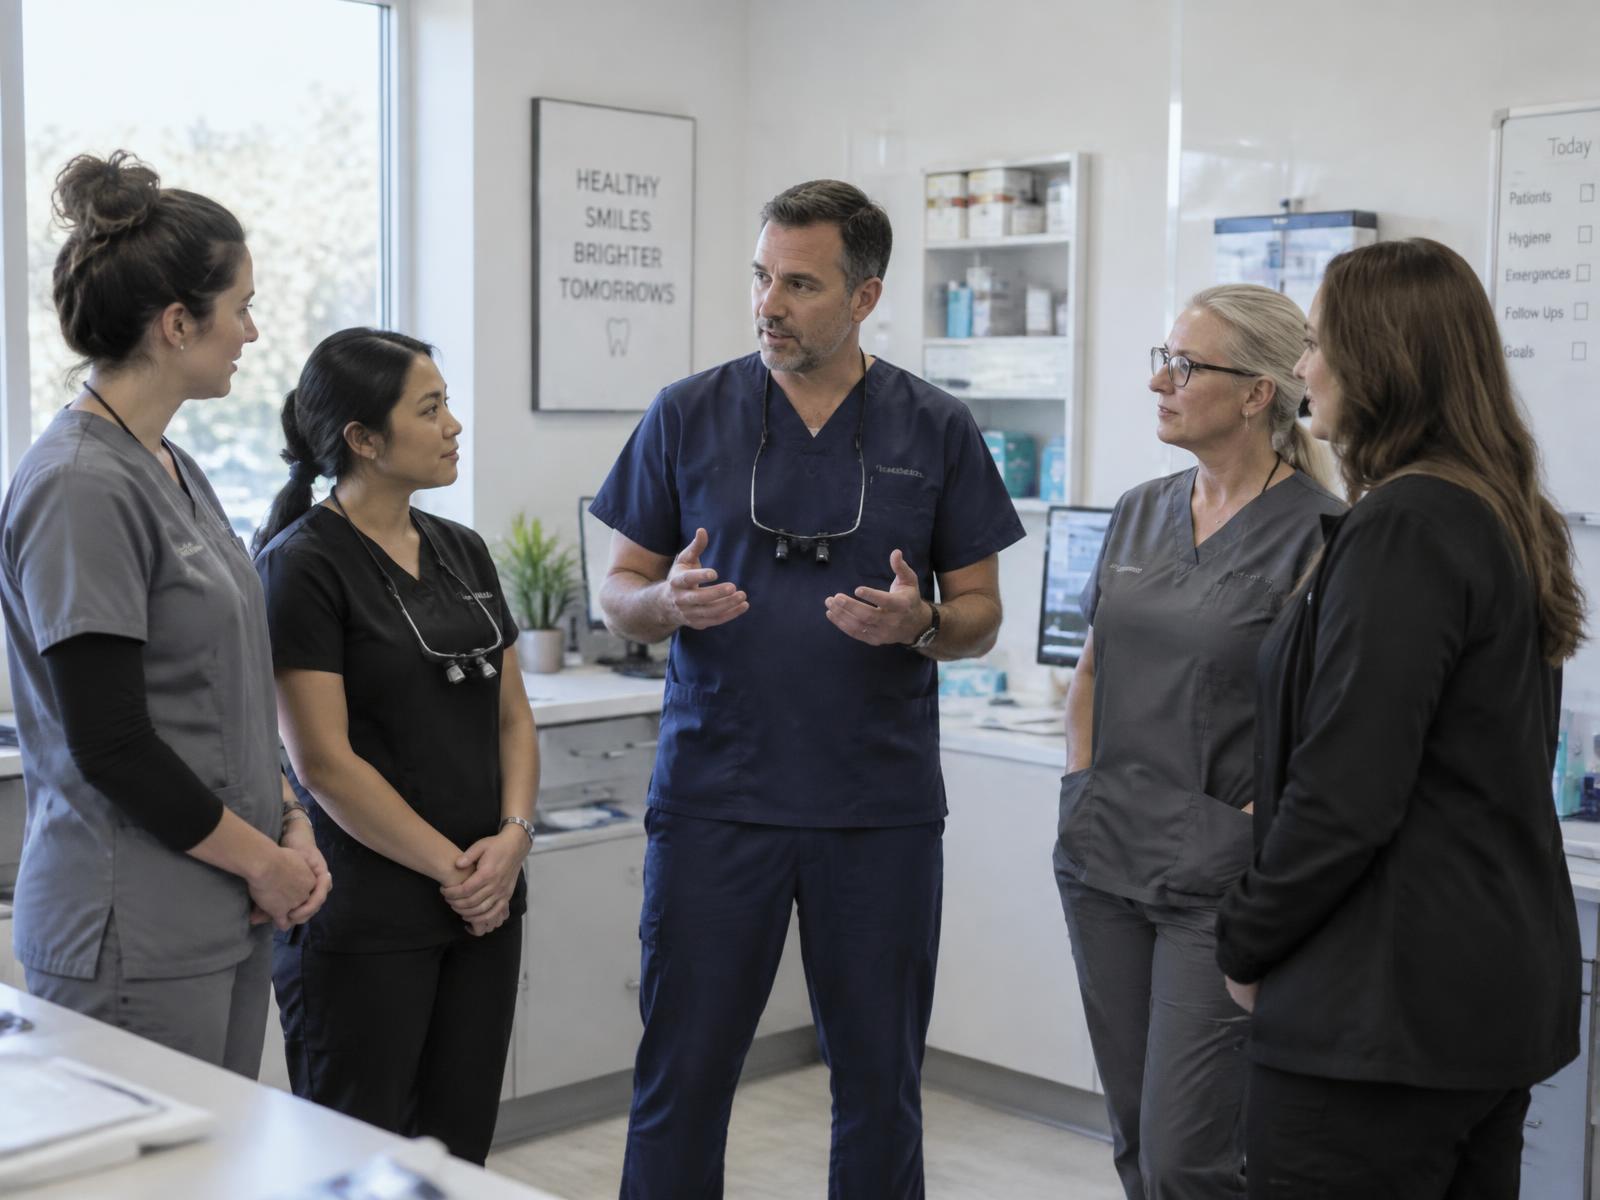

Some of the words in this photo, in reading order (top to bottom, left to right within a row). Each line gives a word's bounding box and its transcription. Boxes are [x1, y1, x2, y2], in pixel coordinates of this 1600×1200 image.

[1547, 135, 1592, 160] Today
[576, 168, 661, 198] HEALTHY
[585, 206, 651, 232] SMILES
[1508, 231, 1551, 248] Hygiene
[573, 241, 663, 269] BRIGHTER
[560, 277, 675, 304] TOMORROWS
[1505, 306, 1539, 320] Follow
[1543, 305, 1564, 322] Ups
[1504, 345, 1535, 359] Goals
